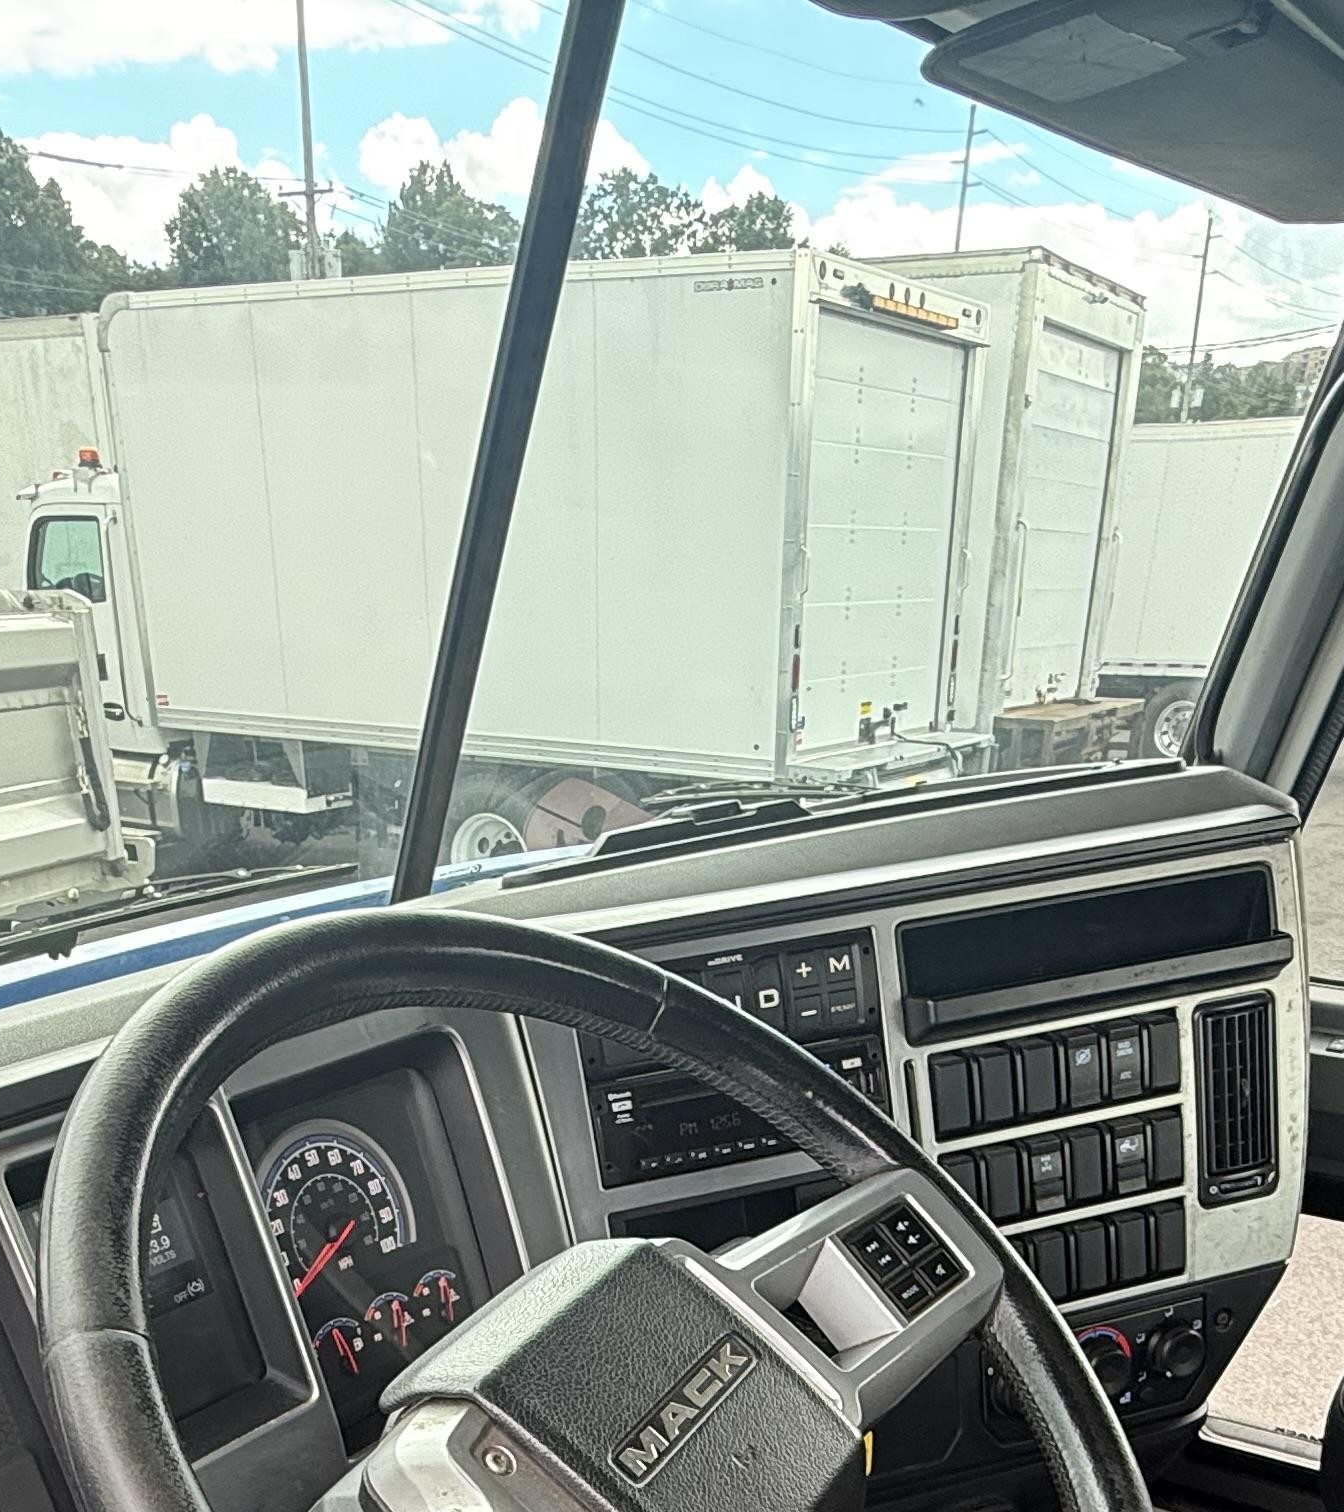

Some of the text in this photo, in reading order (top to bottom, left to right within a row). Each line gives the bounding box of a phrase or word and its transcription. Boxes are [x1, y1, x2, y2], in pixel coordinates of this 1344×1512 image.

[828, 954, 851, 974] M
[758, 988, 780, 1009] D
[304, 1149, 320, 1167] 50
[327, 1148, 343, 1166] 60
[287, 1163, 302, 1181] 40
[349, 1159, 365, 1177] 70
[273, 1189, 289, 1207] 30
[617, 1342, 750, 1478] MACK
